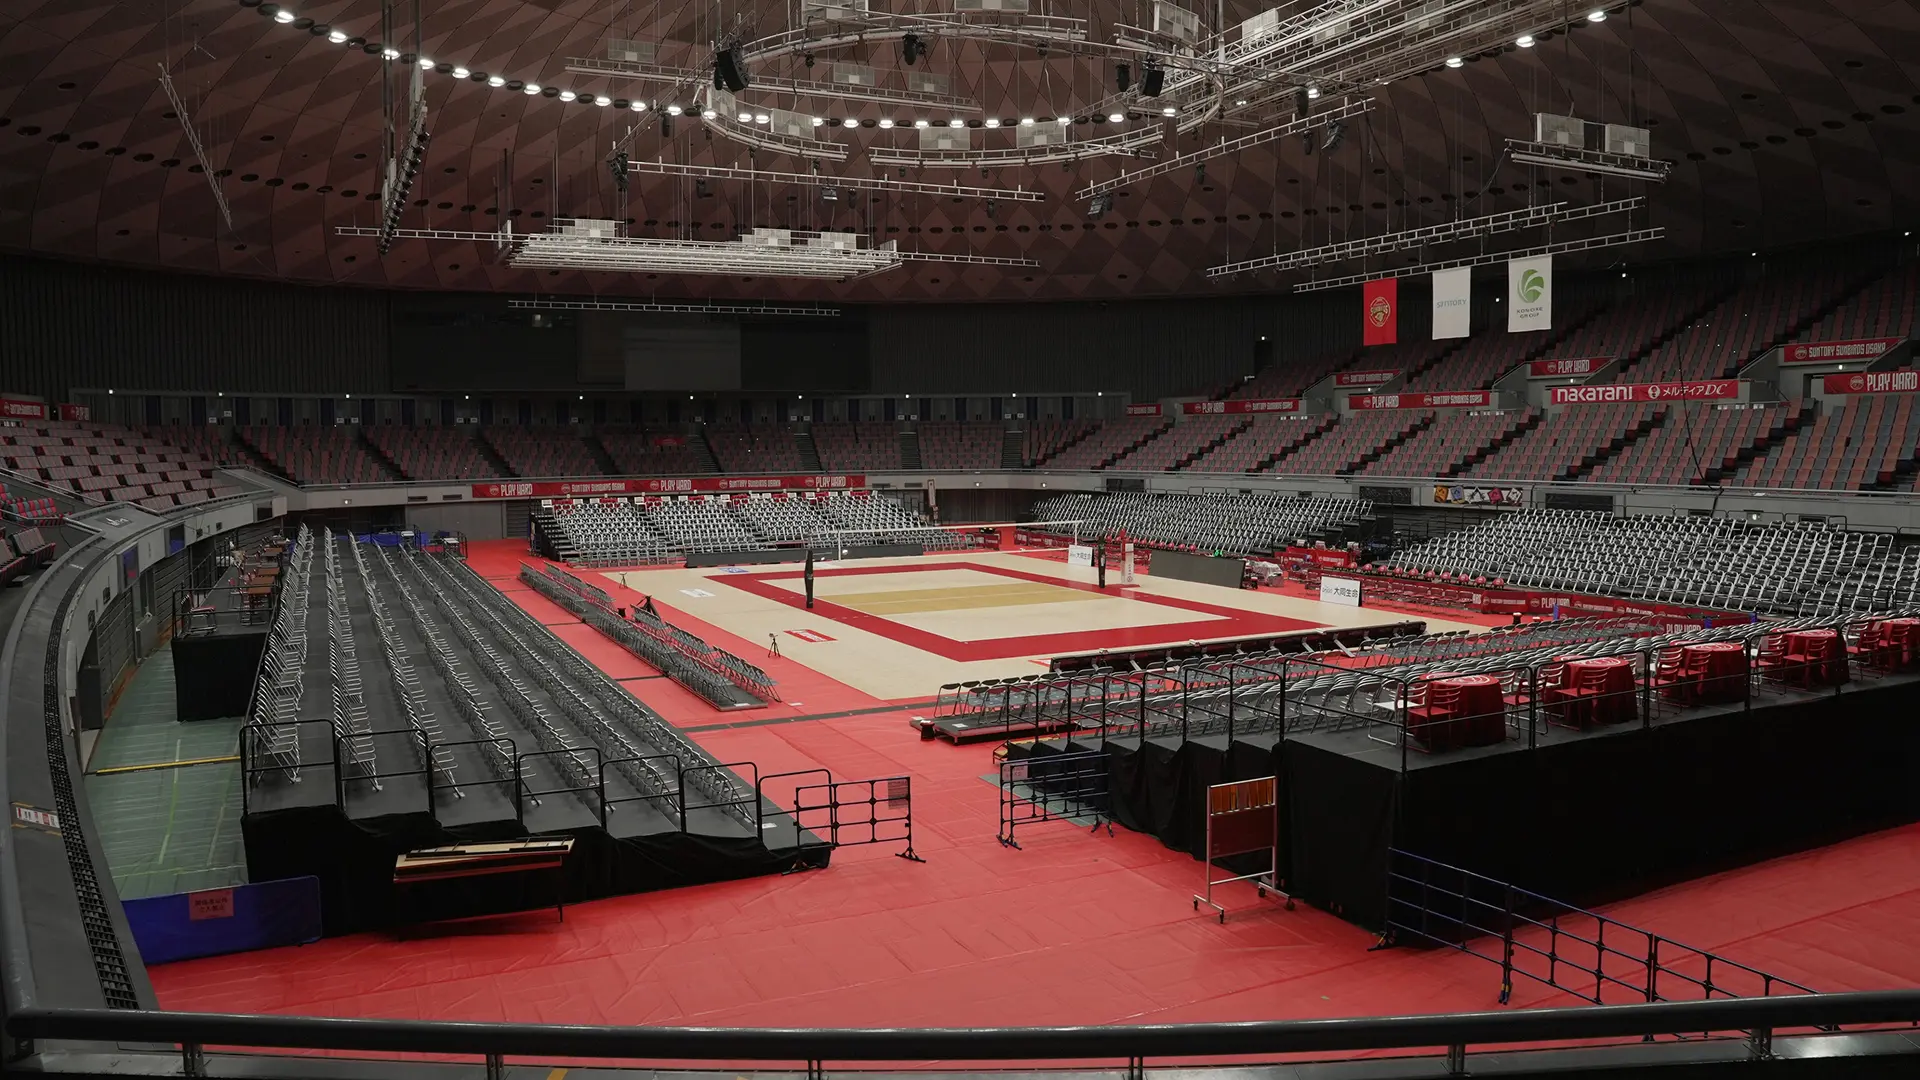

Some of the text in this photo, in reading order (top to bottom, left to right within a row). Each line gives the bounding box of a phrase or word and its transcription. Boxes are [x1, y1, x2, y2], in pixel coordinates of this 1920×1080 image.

[1809, 345, 1835, 357] SUNTORY
[1558, 360, 1573, 373] PLAY
[1867, 372, 1917, 391] PLAY HARD
[660, 480, 676, 491] PLAY
[815, 476, 830, 488] PLAY
[500, 485, 516, 496] PLAY
